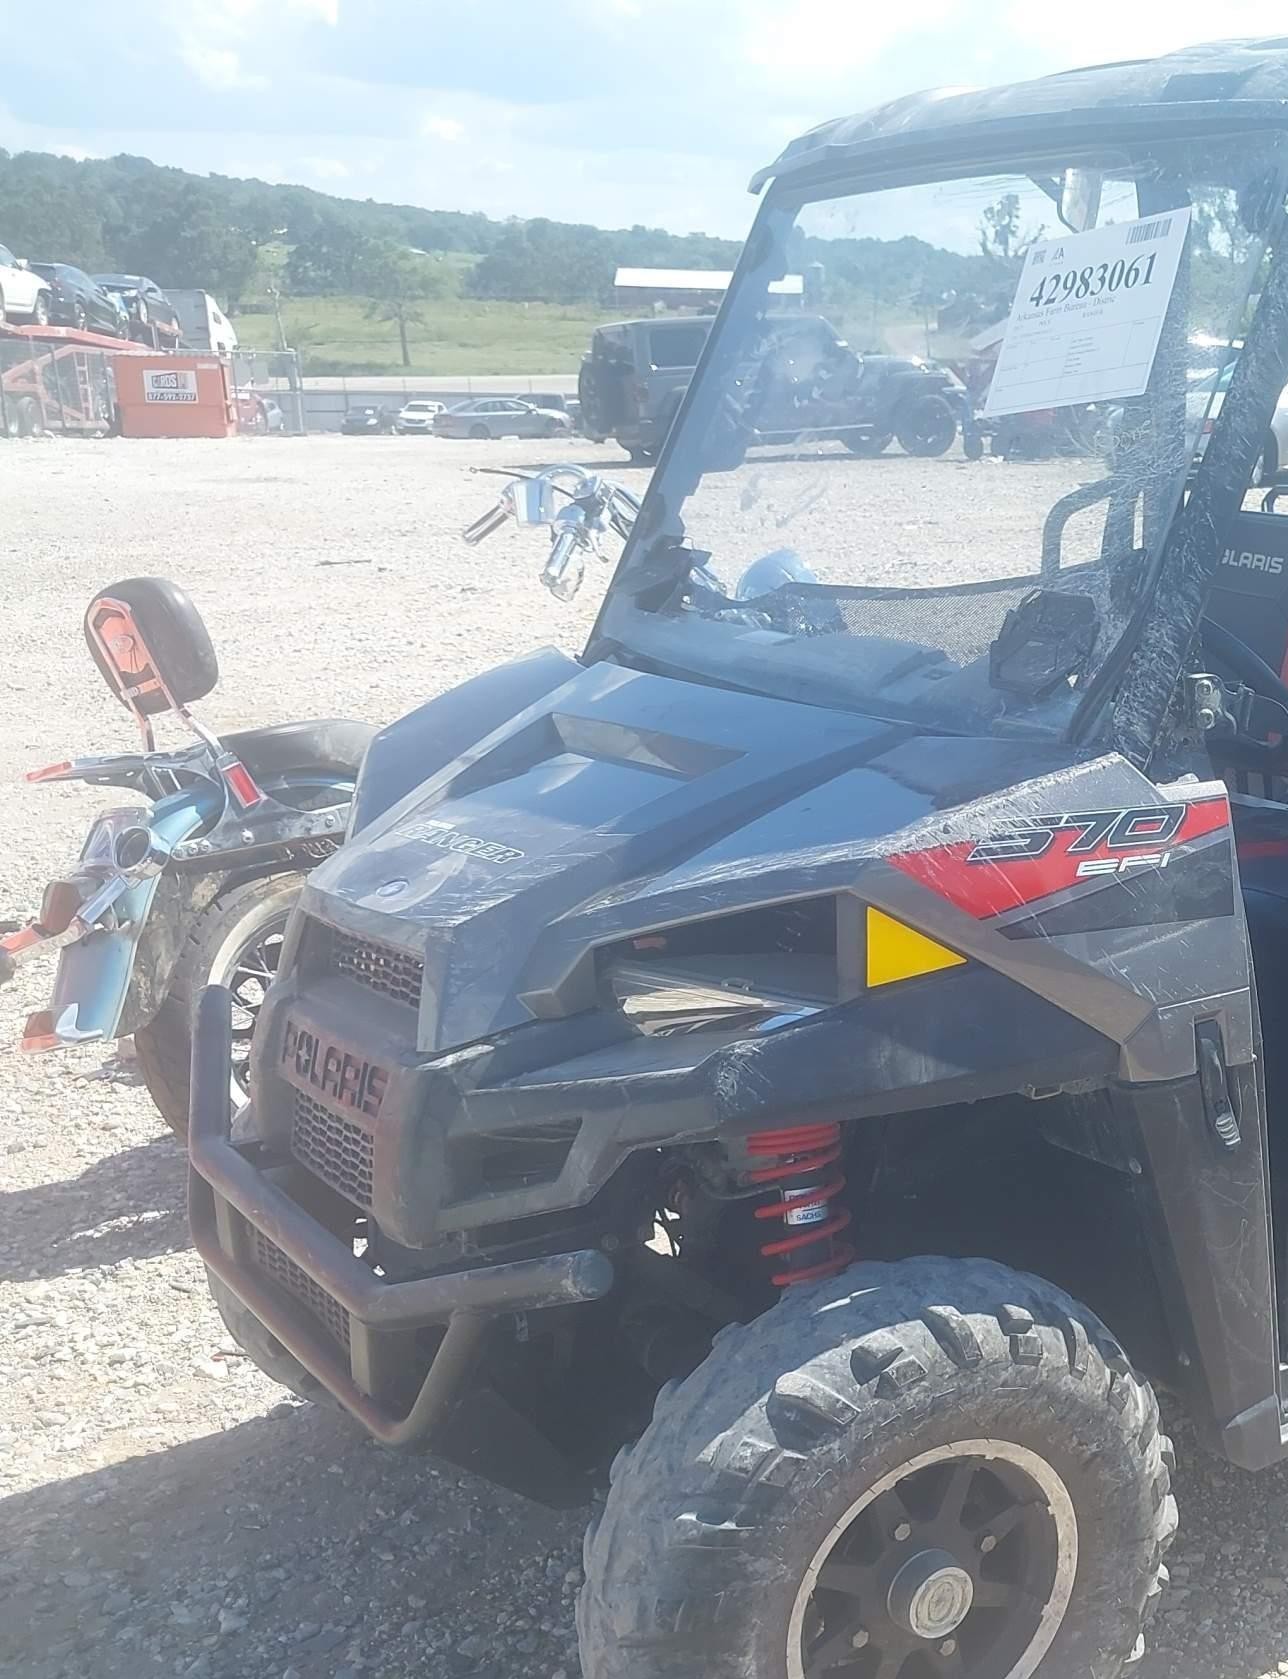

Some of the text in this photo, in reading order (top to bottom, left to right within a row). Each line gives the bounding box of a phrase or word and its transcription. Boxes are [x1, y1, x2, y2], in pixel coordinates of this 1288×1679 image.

[1029, 251, 1157, 308] 42983061
[1221, 548, 1284, 574] LARIS
[395, 823, 526, 865] RANGER
[966, 803, 1186, 862] 570
[1076, 852, 1171, 877] EFI
[282, 1020, 390, 1119] POLARIS
